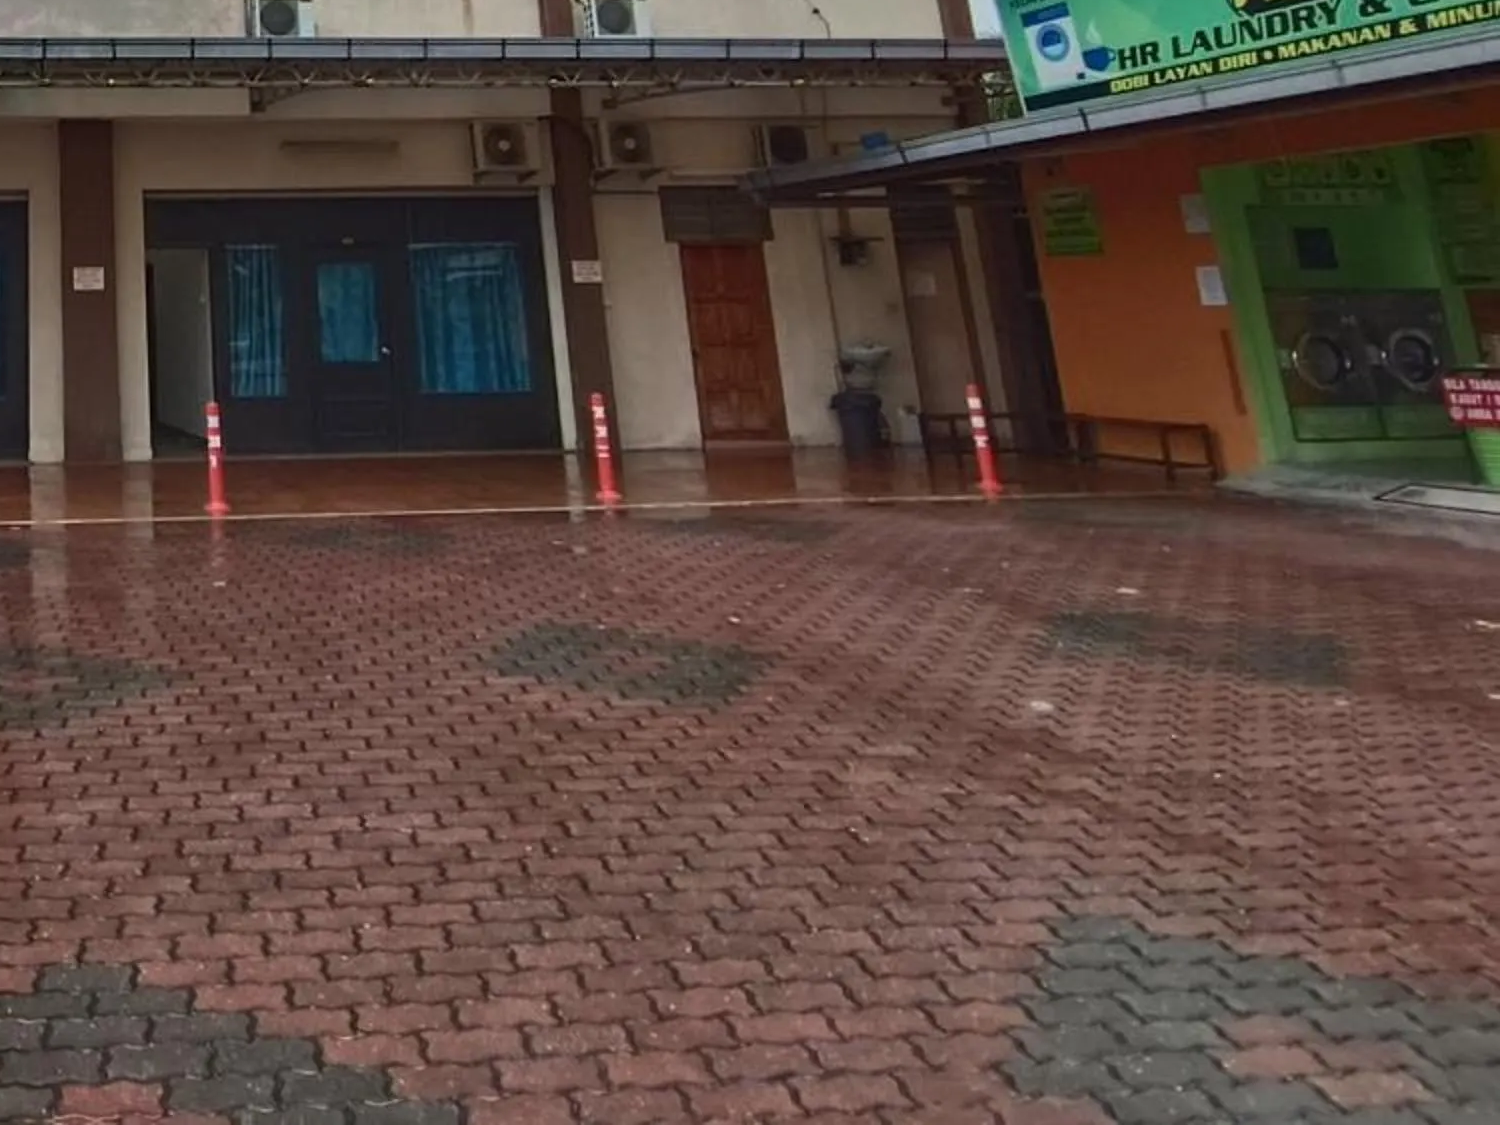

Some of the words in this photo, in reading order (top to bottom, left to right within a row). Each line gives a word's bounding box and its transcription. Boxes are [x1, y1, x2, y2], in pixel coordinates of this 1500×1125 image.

[1110, 77, 1150, 93] DOBI
[1155, 61, 1213, 85] LAYAN
[1219, 51, 1257, 70] DIRI
[1278, 24, 1391, 59] MAKANAN
[1399, 18, 1418, 35] &
[1118, 41, 1161, 70] HR
